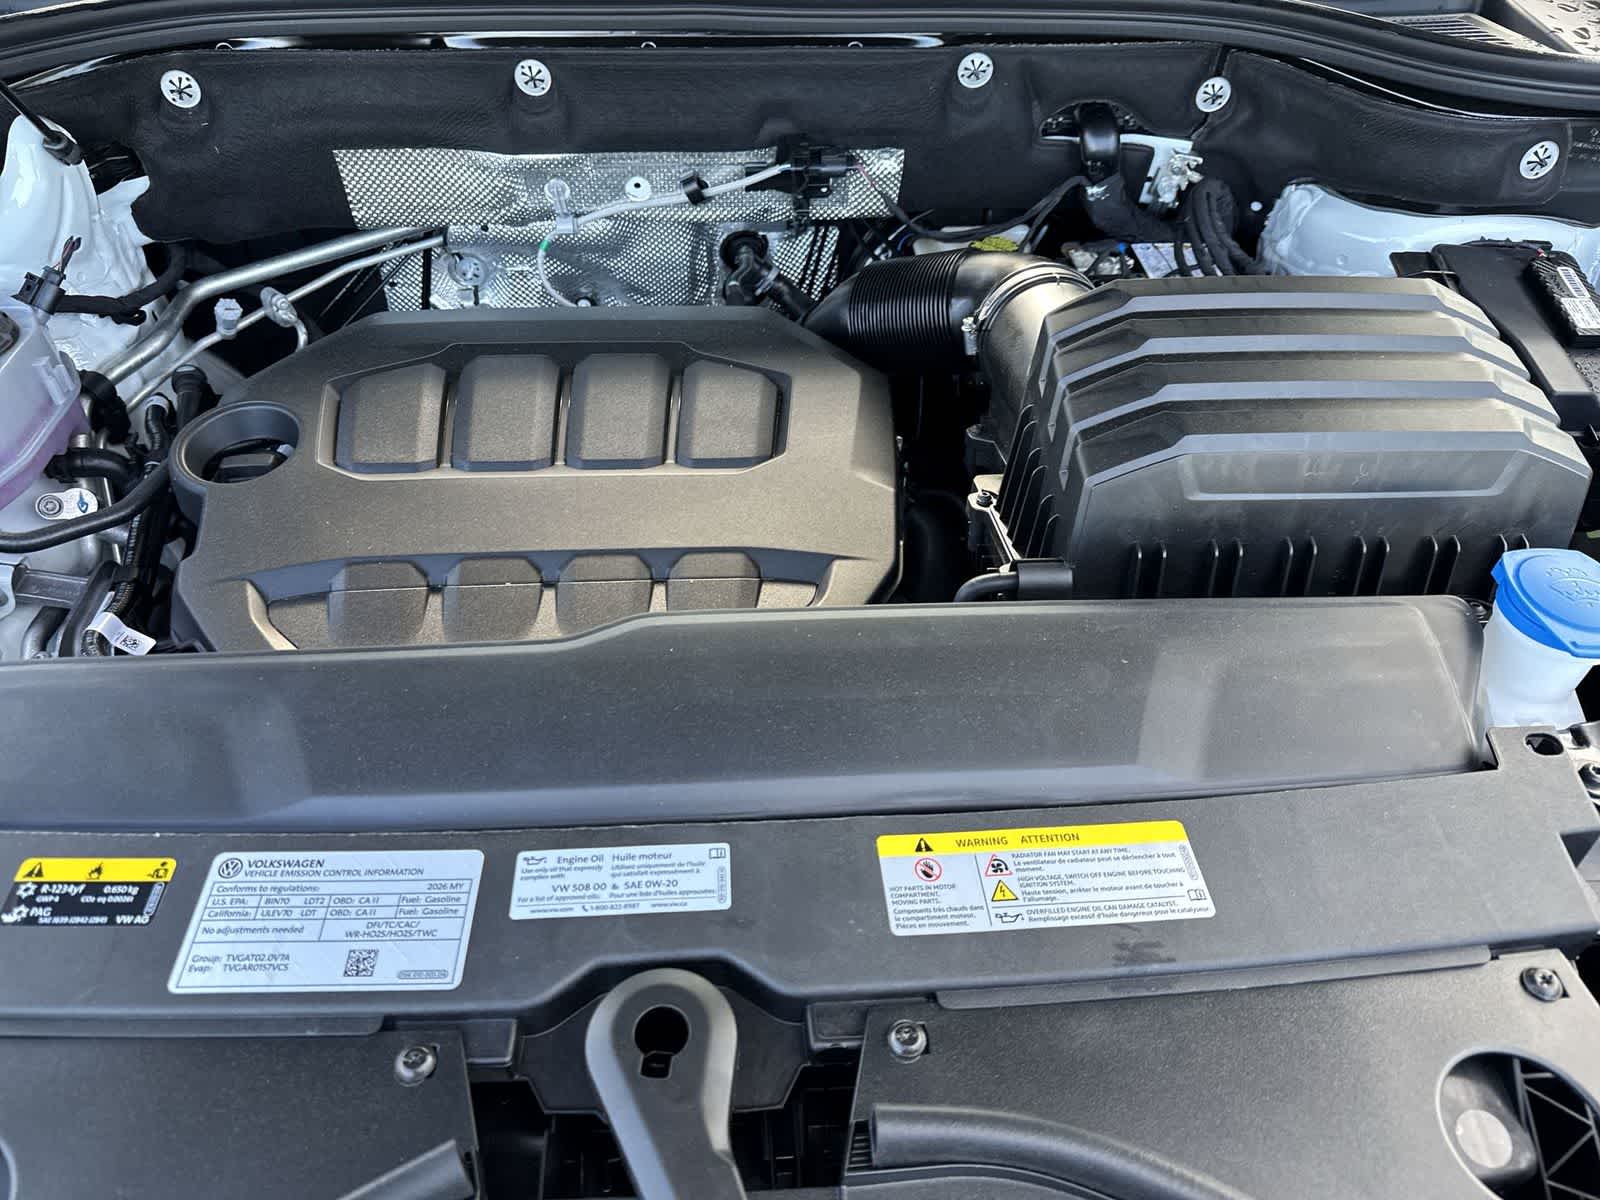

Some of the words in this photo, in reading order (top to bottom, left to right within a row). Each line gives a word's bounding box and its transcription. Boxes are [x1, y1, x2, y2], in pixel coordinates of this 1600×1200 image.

[956, 837, 1008, 847] WARNING
[1020, 833, 1080, 844] ATTENTION
[557, 855, 588, 864] Engine
[590, 854, 604, 863] Oil
[612, 853, 637, 861] Huile
[638, 852, 672, 860] moteur
[248, 860, 325, 868] VOLKSWAGEN
[323, 869, 361, 877] CONTROL
[364, 868, 424, 876] INFORMATION
[40, 883, 86, 896] R-1234yf
[270, 885, 320, 895] regulations:
[449, 882, 464, 890] MY
[572, 884, 590, 892] 508
[624, 881, 643, 889] SAE
[645, 880, 679, 888] 0W-20
[30, 907, 52, 917] PAG
[422, 907, 458, 915] Gasoline
[115, 915, 134, 924] VW
[133, 915, 150, 924] AG
[216, 926, 270, 936] adjustments
[271, 926, 305, 934] needed
